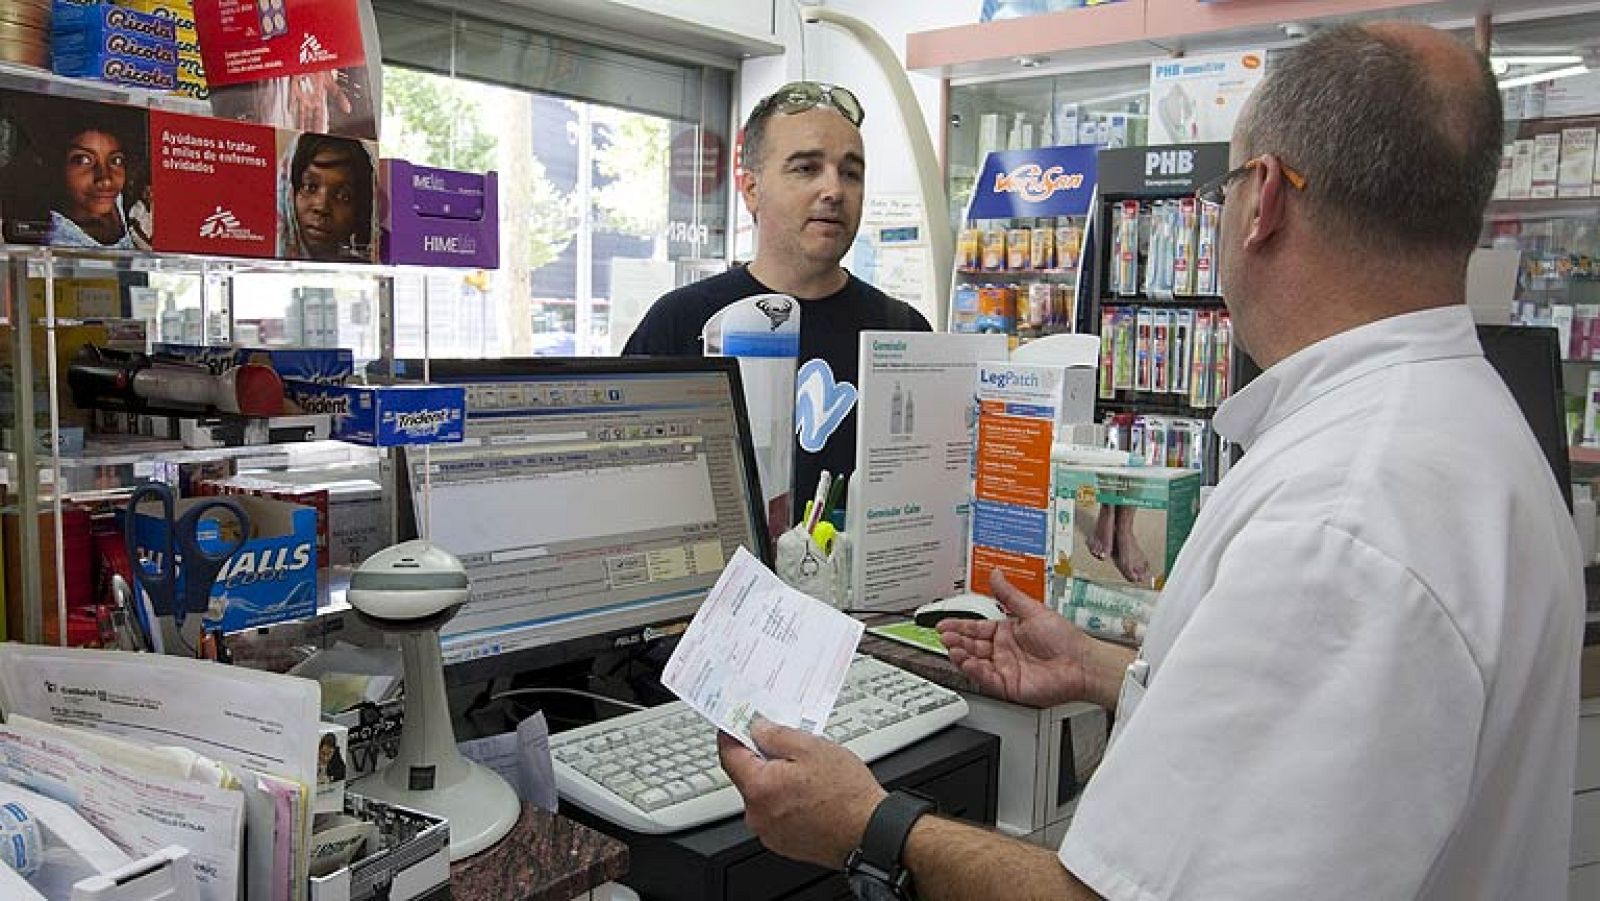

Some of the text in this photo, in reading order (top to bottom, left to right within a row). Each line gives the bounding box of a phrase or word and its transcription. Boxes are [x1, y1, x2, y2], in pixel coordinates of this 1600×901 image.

[107, 9, 173, 38] Ricola
[107, 34, 174, 63] Ricola
[106, 59, 174, 88] Ricola
[162, 131, 256, 154] Ayúdanos a tratar
[162, 146, 268, 168] a miles de enfermos
[162, 158, 216, 174] olvidados
[1145, 149, 1194, 176] PHB
[980, 368, 1039, 389] LegPatch
[299, 392, 348, 413] Trident
[398, 407, 450, 430] Trident
